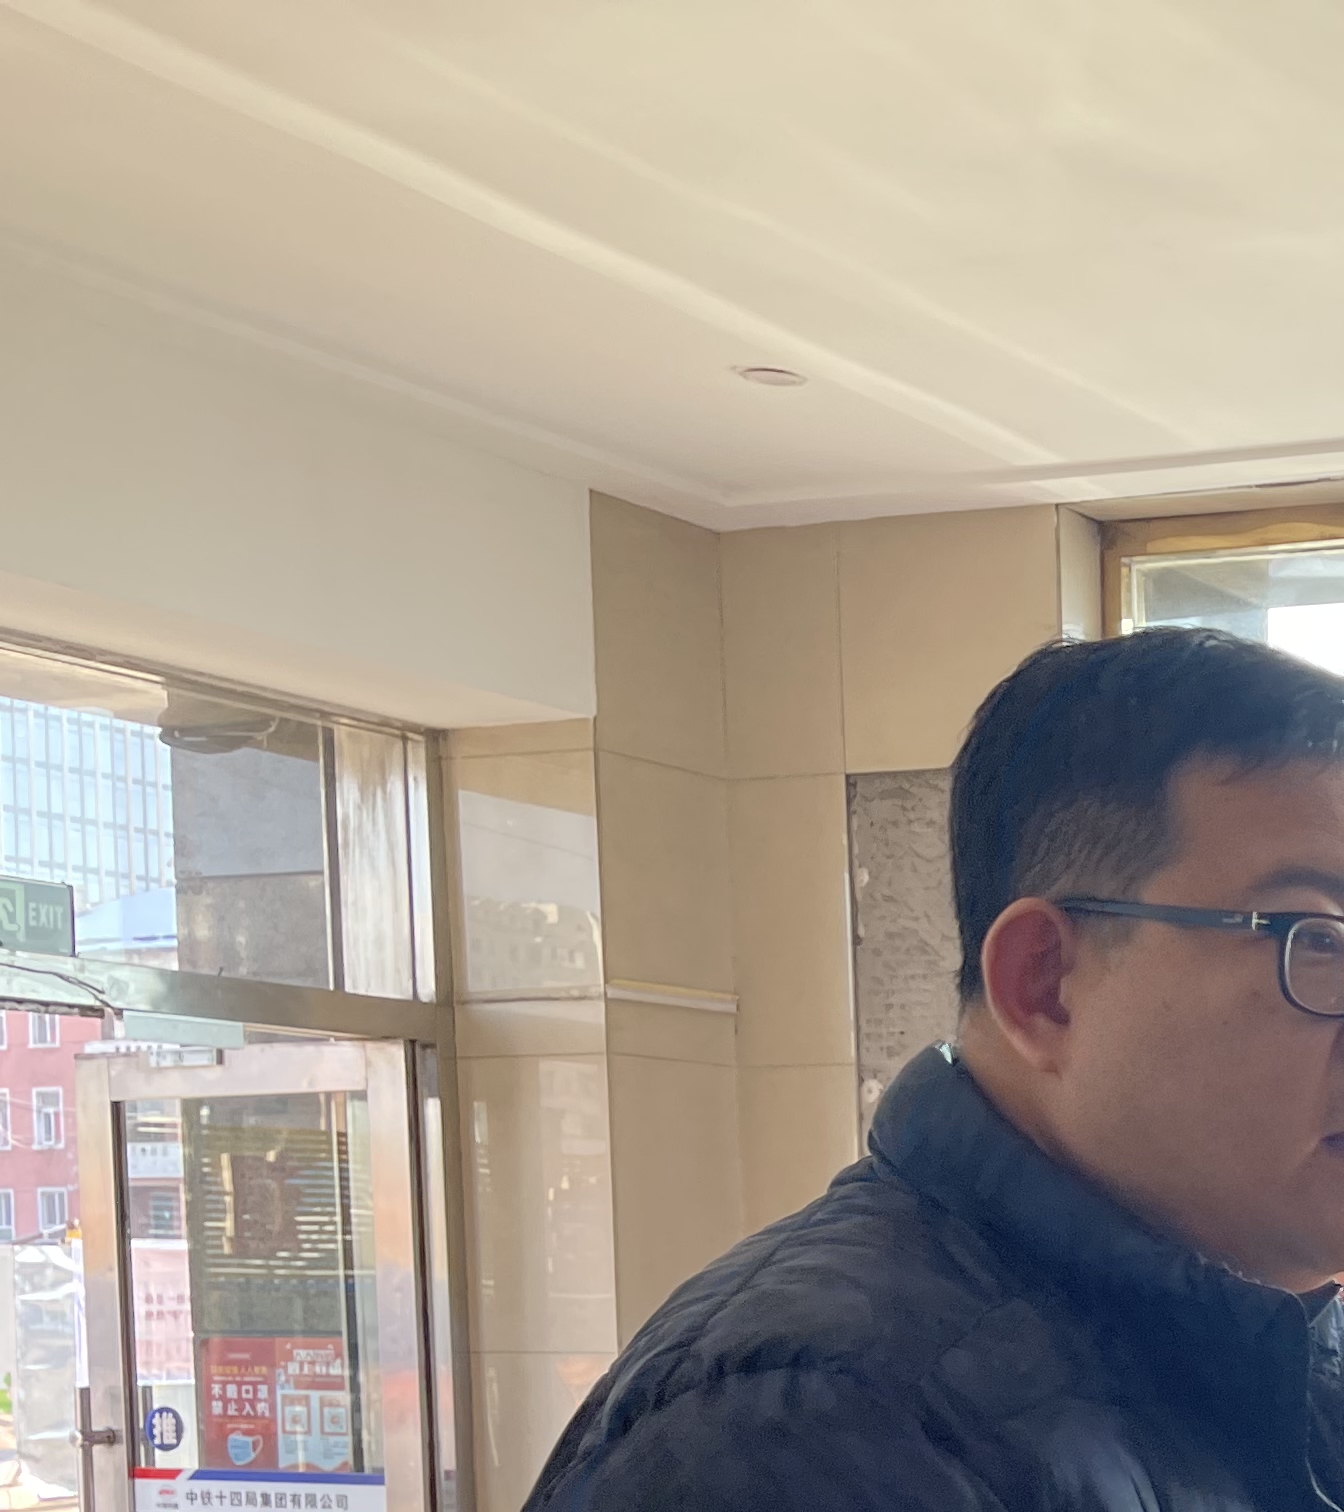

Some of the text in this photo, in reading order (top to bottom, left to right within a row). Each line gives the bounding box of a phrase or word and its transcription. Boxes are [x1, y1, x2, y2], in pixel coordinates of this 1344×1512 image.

[30, 903, 64, 929] EXIT
[152, 1411, 177, 1445] 推
[185, 1488, 349, 1511] 中铁十四局集团有限公司
